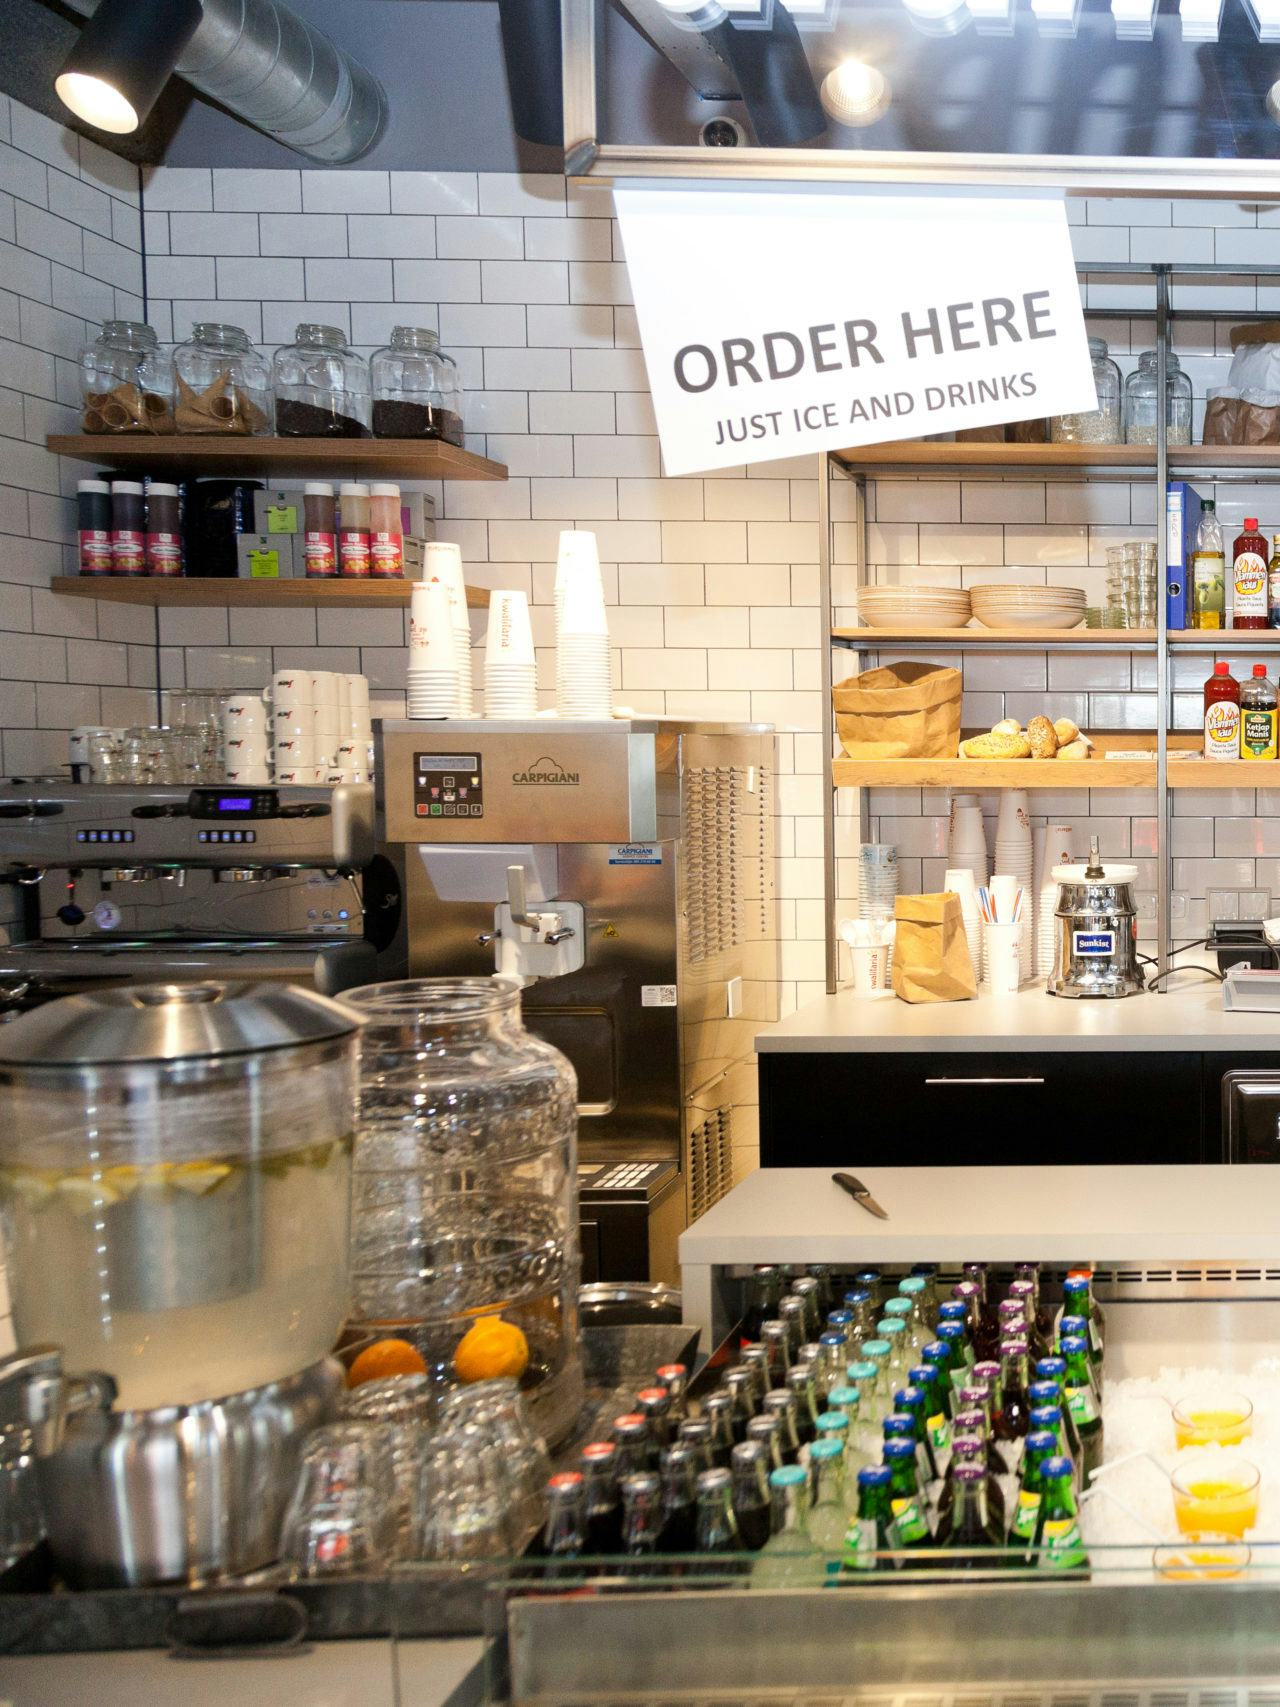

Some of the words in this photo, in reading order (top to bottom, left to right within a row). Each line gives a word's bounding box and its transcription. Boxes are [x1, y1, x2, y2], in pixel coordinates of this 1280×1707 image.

[673, 318, 885, 394] ORDER
[901, 290, 1056, 359] HERE
[715, 411, 783, 445] JUST
[793, 403, 839, 432] ICE
[849, 391, 915, 424] AND
[924, 372, 1038, 411] DRINKS
[1246, 723, 1270, 733] Ketjap
[1246, 730, 1269, 738] Manis
[512, 772, 580, 783] CARPIGIANI
[1079, 939, 1110, 949] Sunkist
